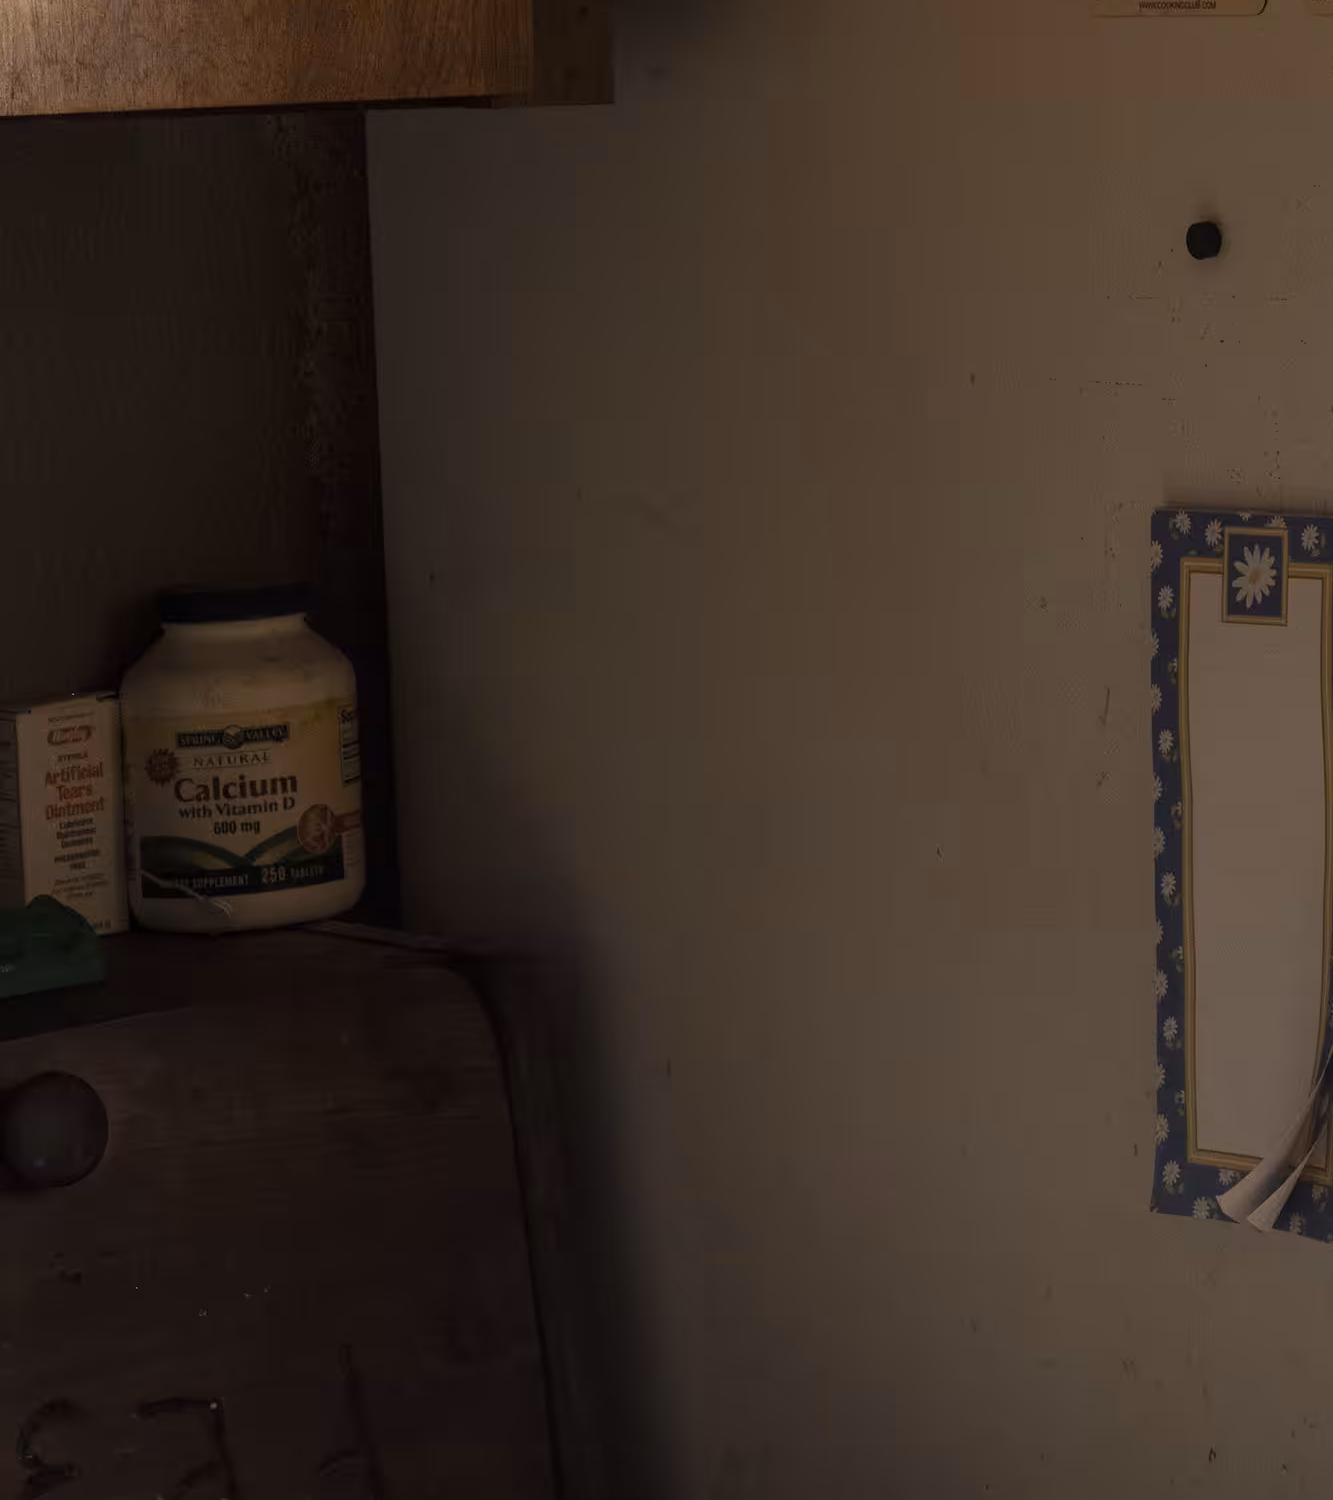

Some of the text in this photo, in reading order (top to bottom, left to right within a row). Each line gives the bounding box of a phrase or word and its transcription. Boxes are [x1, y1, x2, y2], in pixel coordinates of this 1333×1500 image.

[193, 752, 273, 767] NATURAL
[45, 763, 104, 787] Artificial
[56, 784, 93, 801] Tears
[174, 775, 297, 803] Calcium
[45, 797, 105, 821] Ointment
[179, 797, 296, 819] with Vitamin D
[241, 820, 261, 834] mg
[262, 867, 285, 884] 250
